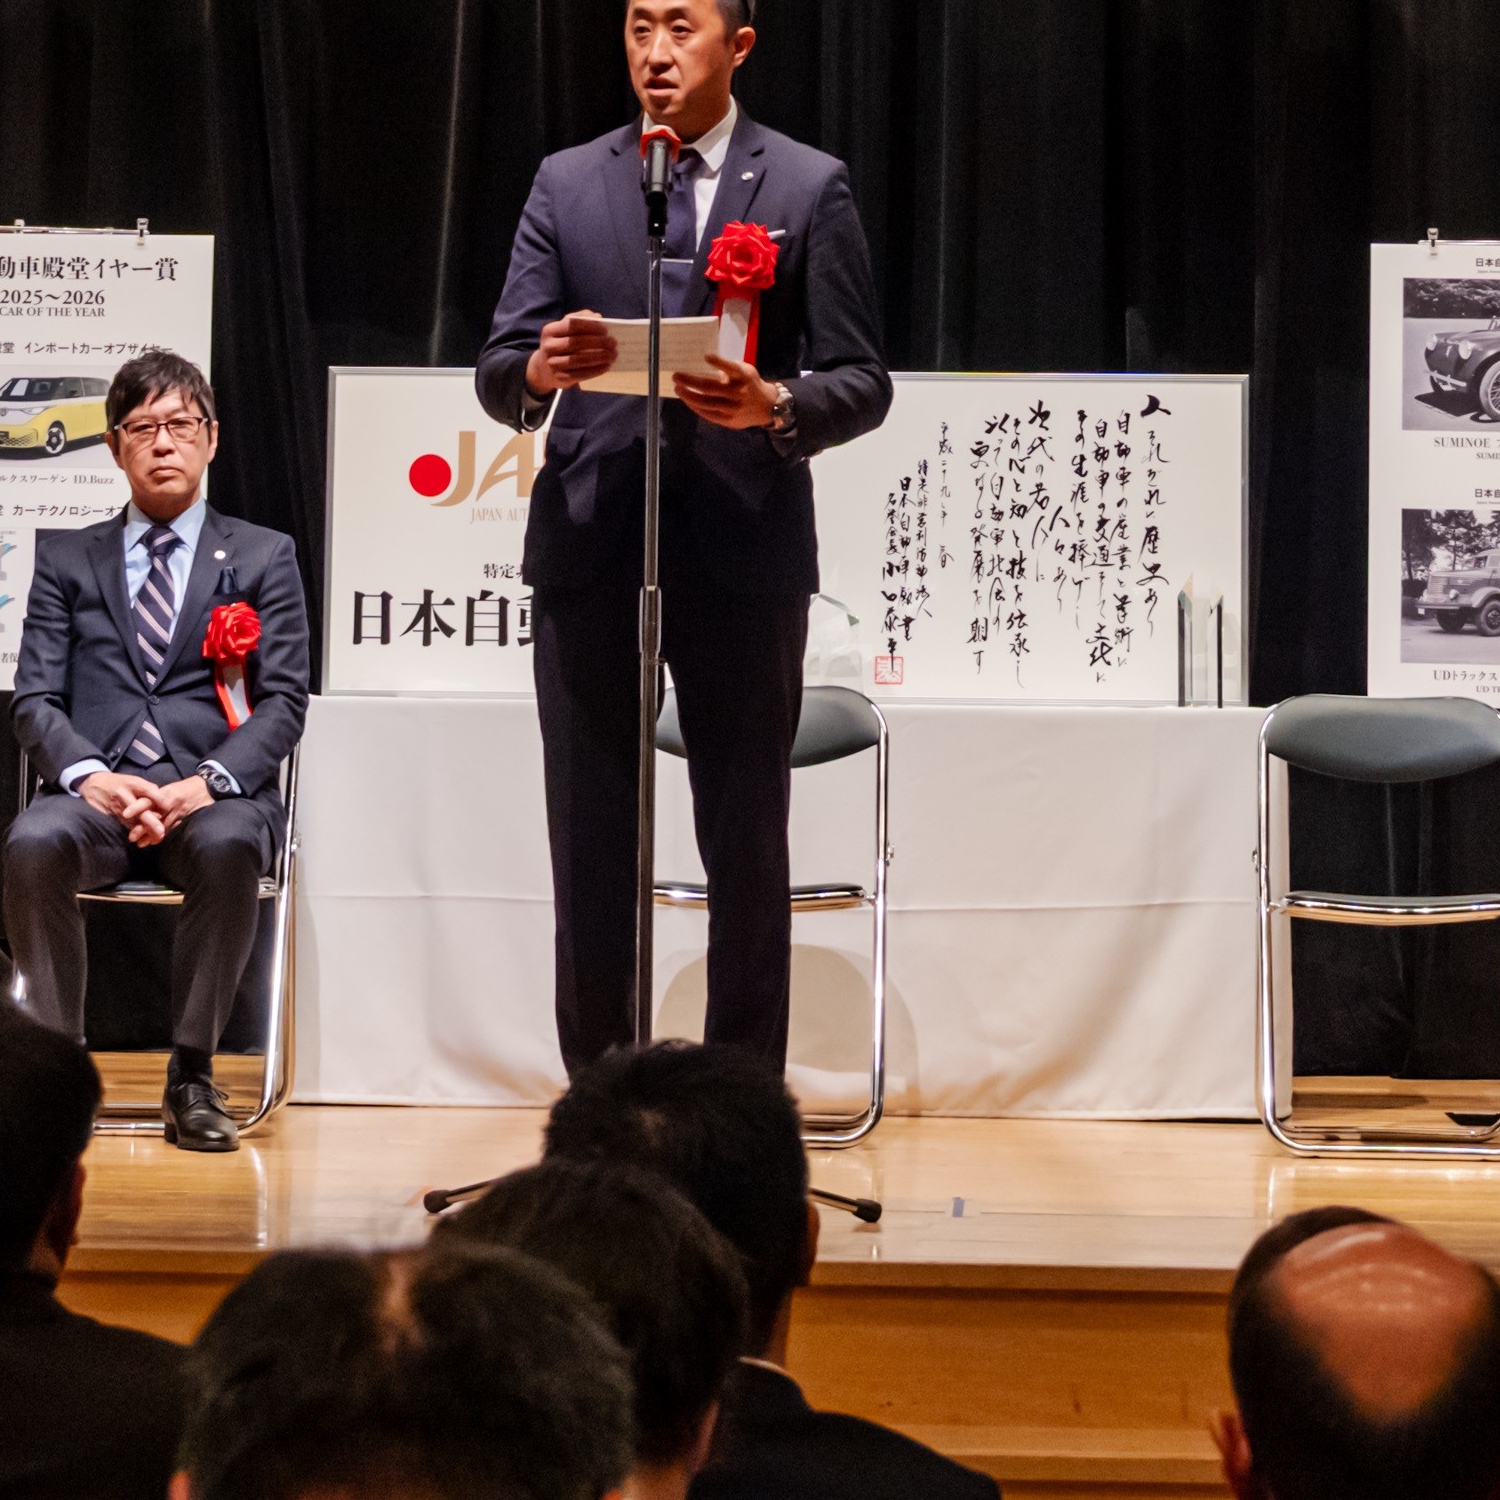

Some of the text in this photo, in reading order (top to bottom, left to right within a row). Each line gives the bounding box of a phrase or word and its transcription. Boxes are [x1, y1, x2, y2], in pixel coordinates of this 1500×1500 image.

[26, 306, 43, 316] OF
[46, 306, 72, 316] THE
[74, 307, 106, 317] YEAR
[1434, 437, 1490, 448] SUMINOE
[12, 504, 123, 517] カーテクノロジーオ
